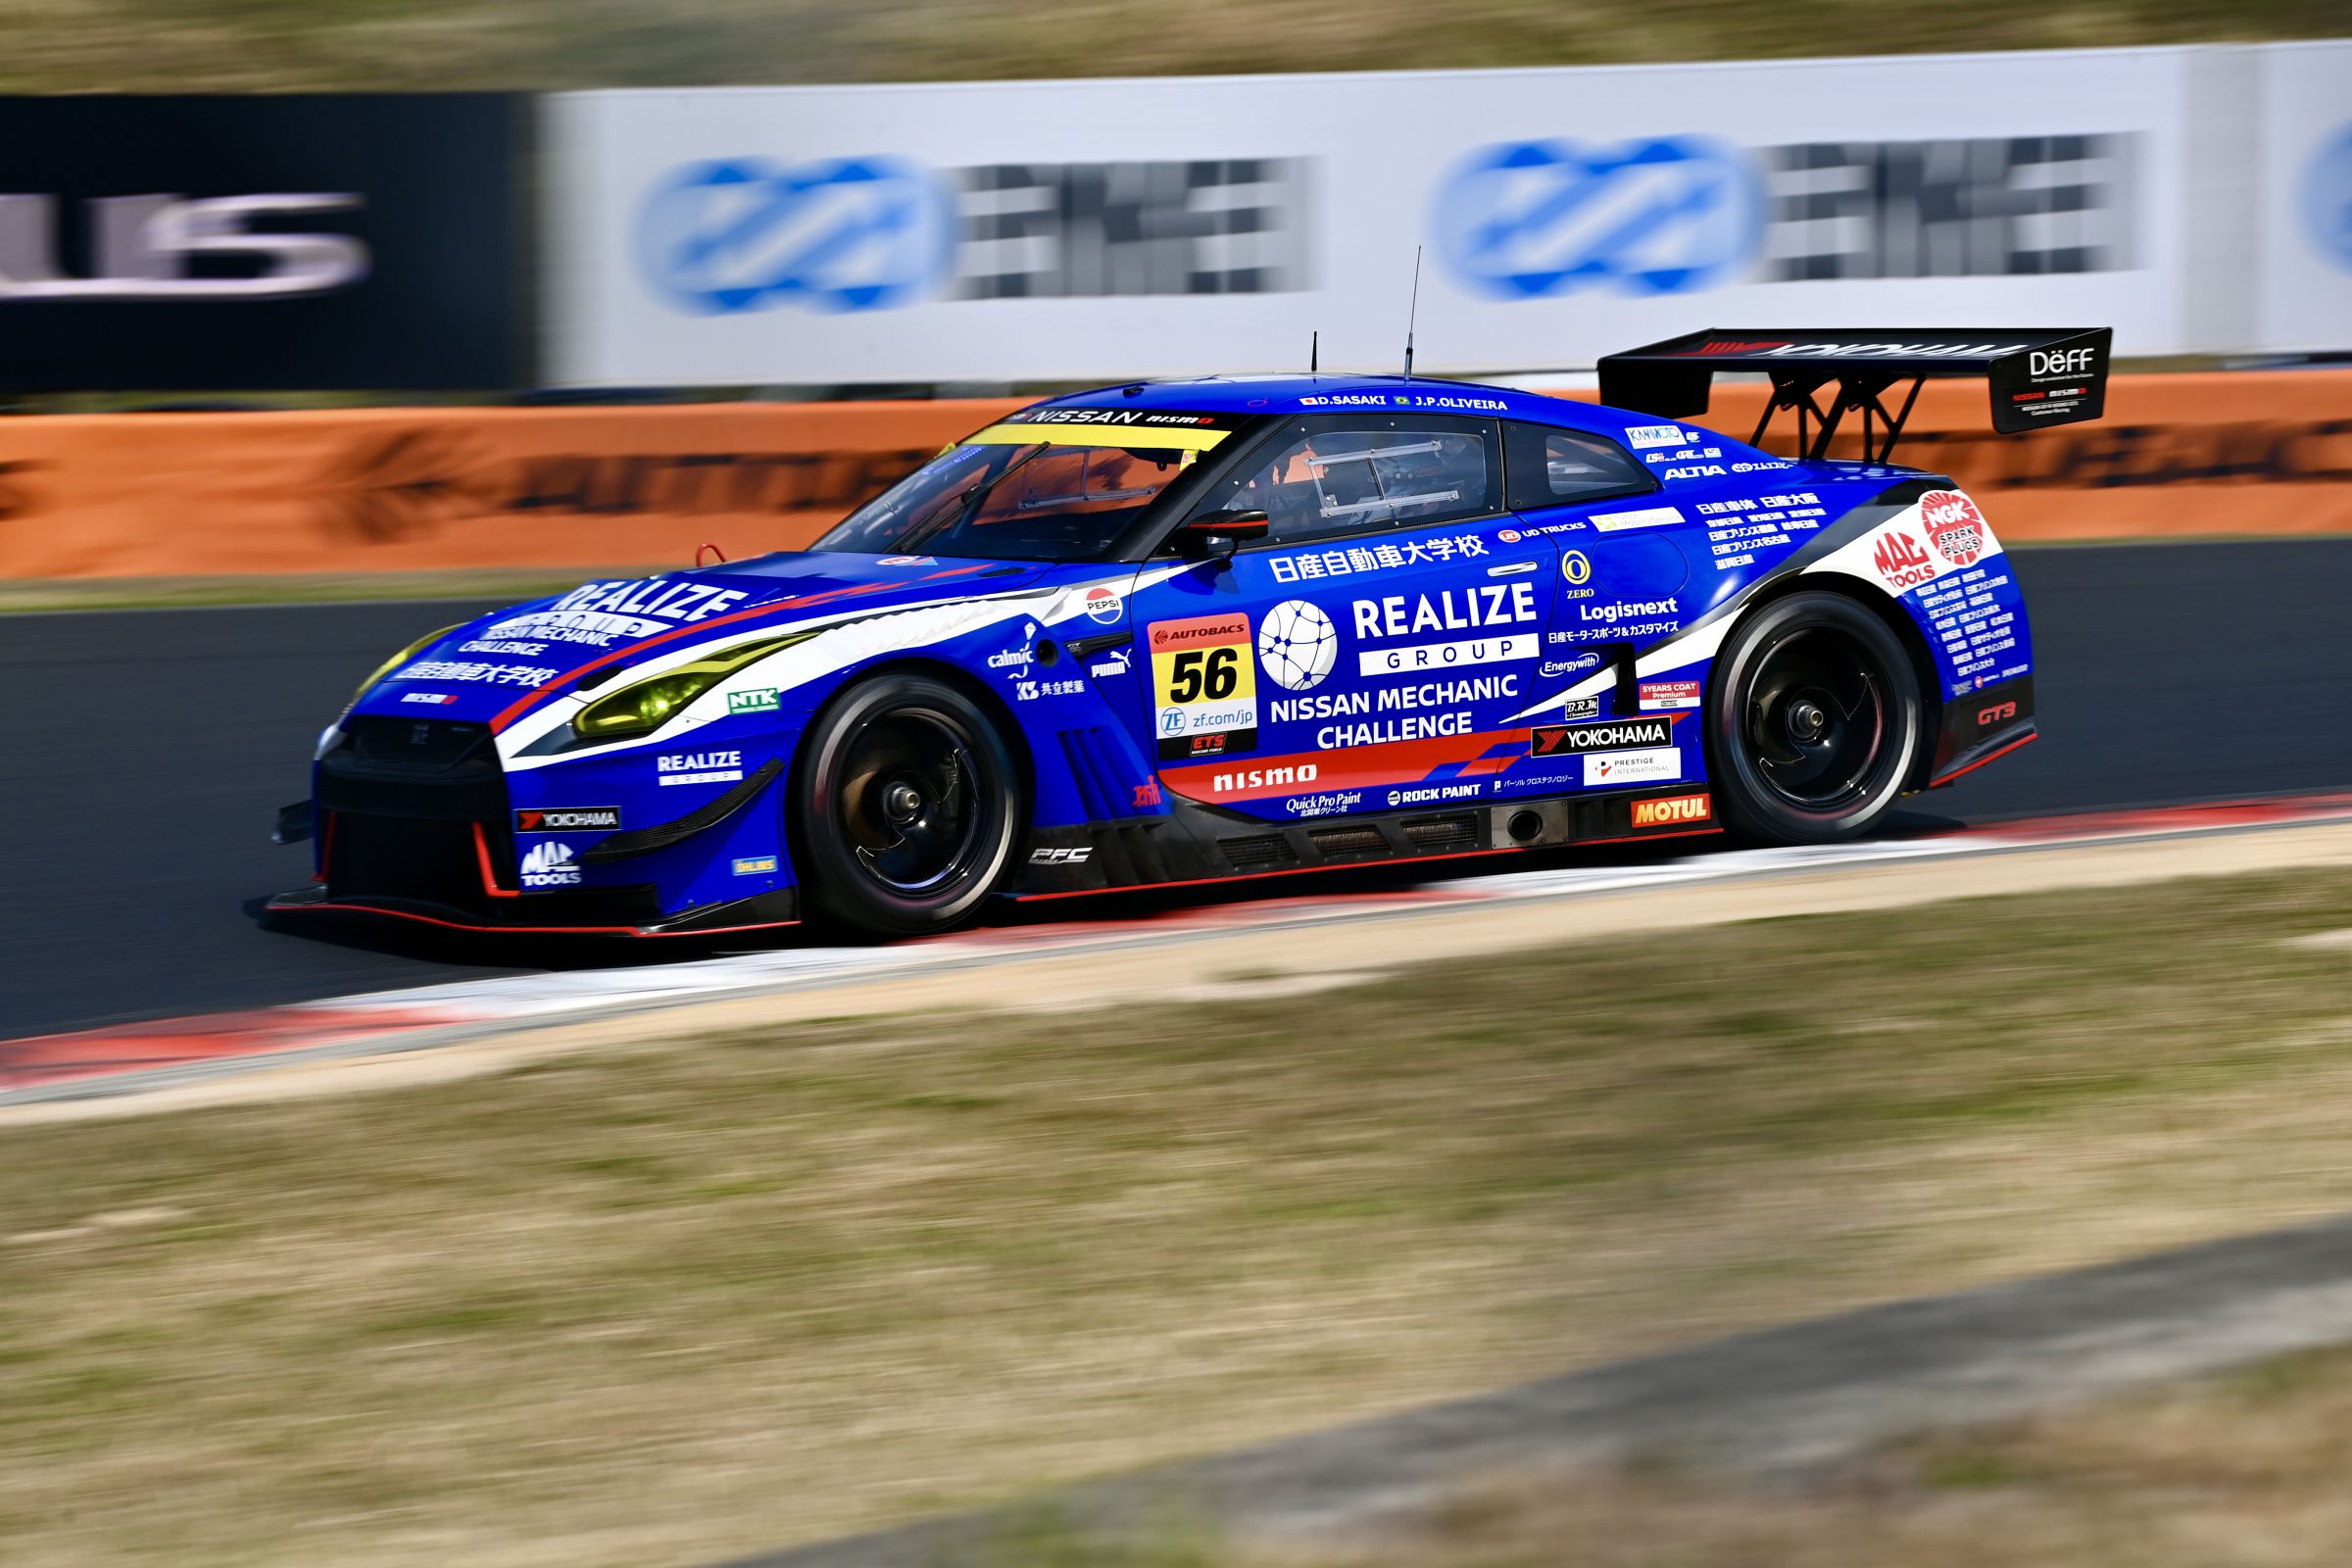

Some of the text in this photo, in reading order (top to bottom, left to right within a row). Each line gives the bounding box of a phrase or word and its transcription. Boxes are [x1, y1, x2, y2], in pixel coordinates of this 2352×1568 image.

[1318, 395, 1508, 411] D.SASAKI J.P.OLIVEIRA
[1028, 410, 1143, 424] NISSAN
[1146, 415, 1214, 424] nismo
[1664, 465, 1727, 480] ALTIA
[1926, 500, 1970, 528] NGK
[1521, 521, 1587, 538] UD TRUCKS
[1939, 525, 1975, 544] SPARK
[1874, 531, 1931, 575] MAC
[1944, 539, 1980, 557] PLUGS
[1269, 534, 1490, 583] 日産自動車大学校
[1886, 564, 1936, 588] TOOLS
[551, 580, 750, 621] REALIZE
[1567, 588, 1595, 599] ZERO
[1087, 600, 1119, 612] PEPSI
[1352, 582, 1538, 639] REALIZE
[1581, 597, 1679, 623] Logisnext
[1169, 624, 1245, 641] AUTOBACS
[1548, 620, 1679, 644] 日産モータースポーツ&カスタマイズ
[988, 649, 1035, 668] calmic
[1387, 640, 1514, 669] GROUP
[1091, 662, 1126, 678] PUMA
[1544, 657, 1596, 673] Energywith
[1170, 648, 1238, 704] 56
[1642, 682, 1697, 694] 5YEARS COAT
[1652, 691, 1687, 700] Premium
[729, 689, 778, 708] NTK
[1271, 674, 1518, 723] NISSAN MECHANIC
[1163, 710, 1252, 731] ZF zf.com/jp
[1978, 701, 2017, 725] GT3
[1317, 711, 1473, 750] CHALLENGE
[1567, 723, 1666, 748] YOKOHAMA
[1193, 734, 1225, 750] ETS
[658, 751, 742, 772] REALIZE
[1614, 758, 1655, 766] PRESTIGE
[1614, 765, 1670, 775] INTERNATIONAL
[1213, 763, 1317, 793] nismo
[1286, 792, 1362, 813] Quick Pro Paint
[1402, 784, 1482, 804] ROCK PAINT
[543, 810, 617, 827] YOKOHAMA
[1636, 797, 1707, 824] MOTUL
[1029, 847, 1094, 861] PFC
[520, 872, 582, 887] TOOLS
